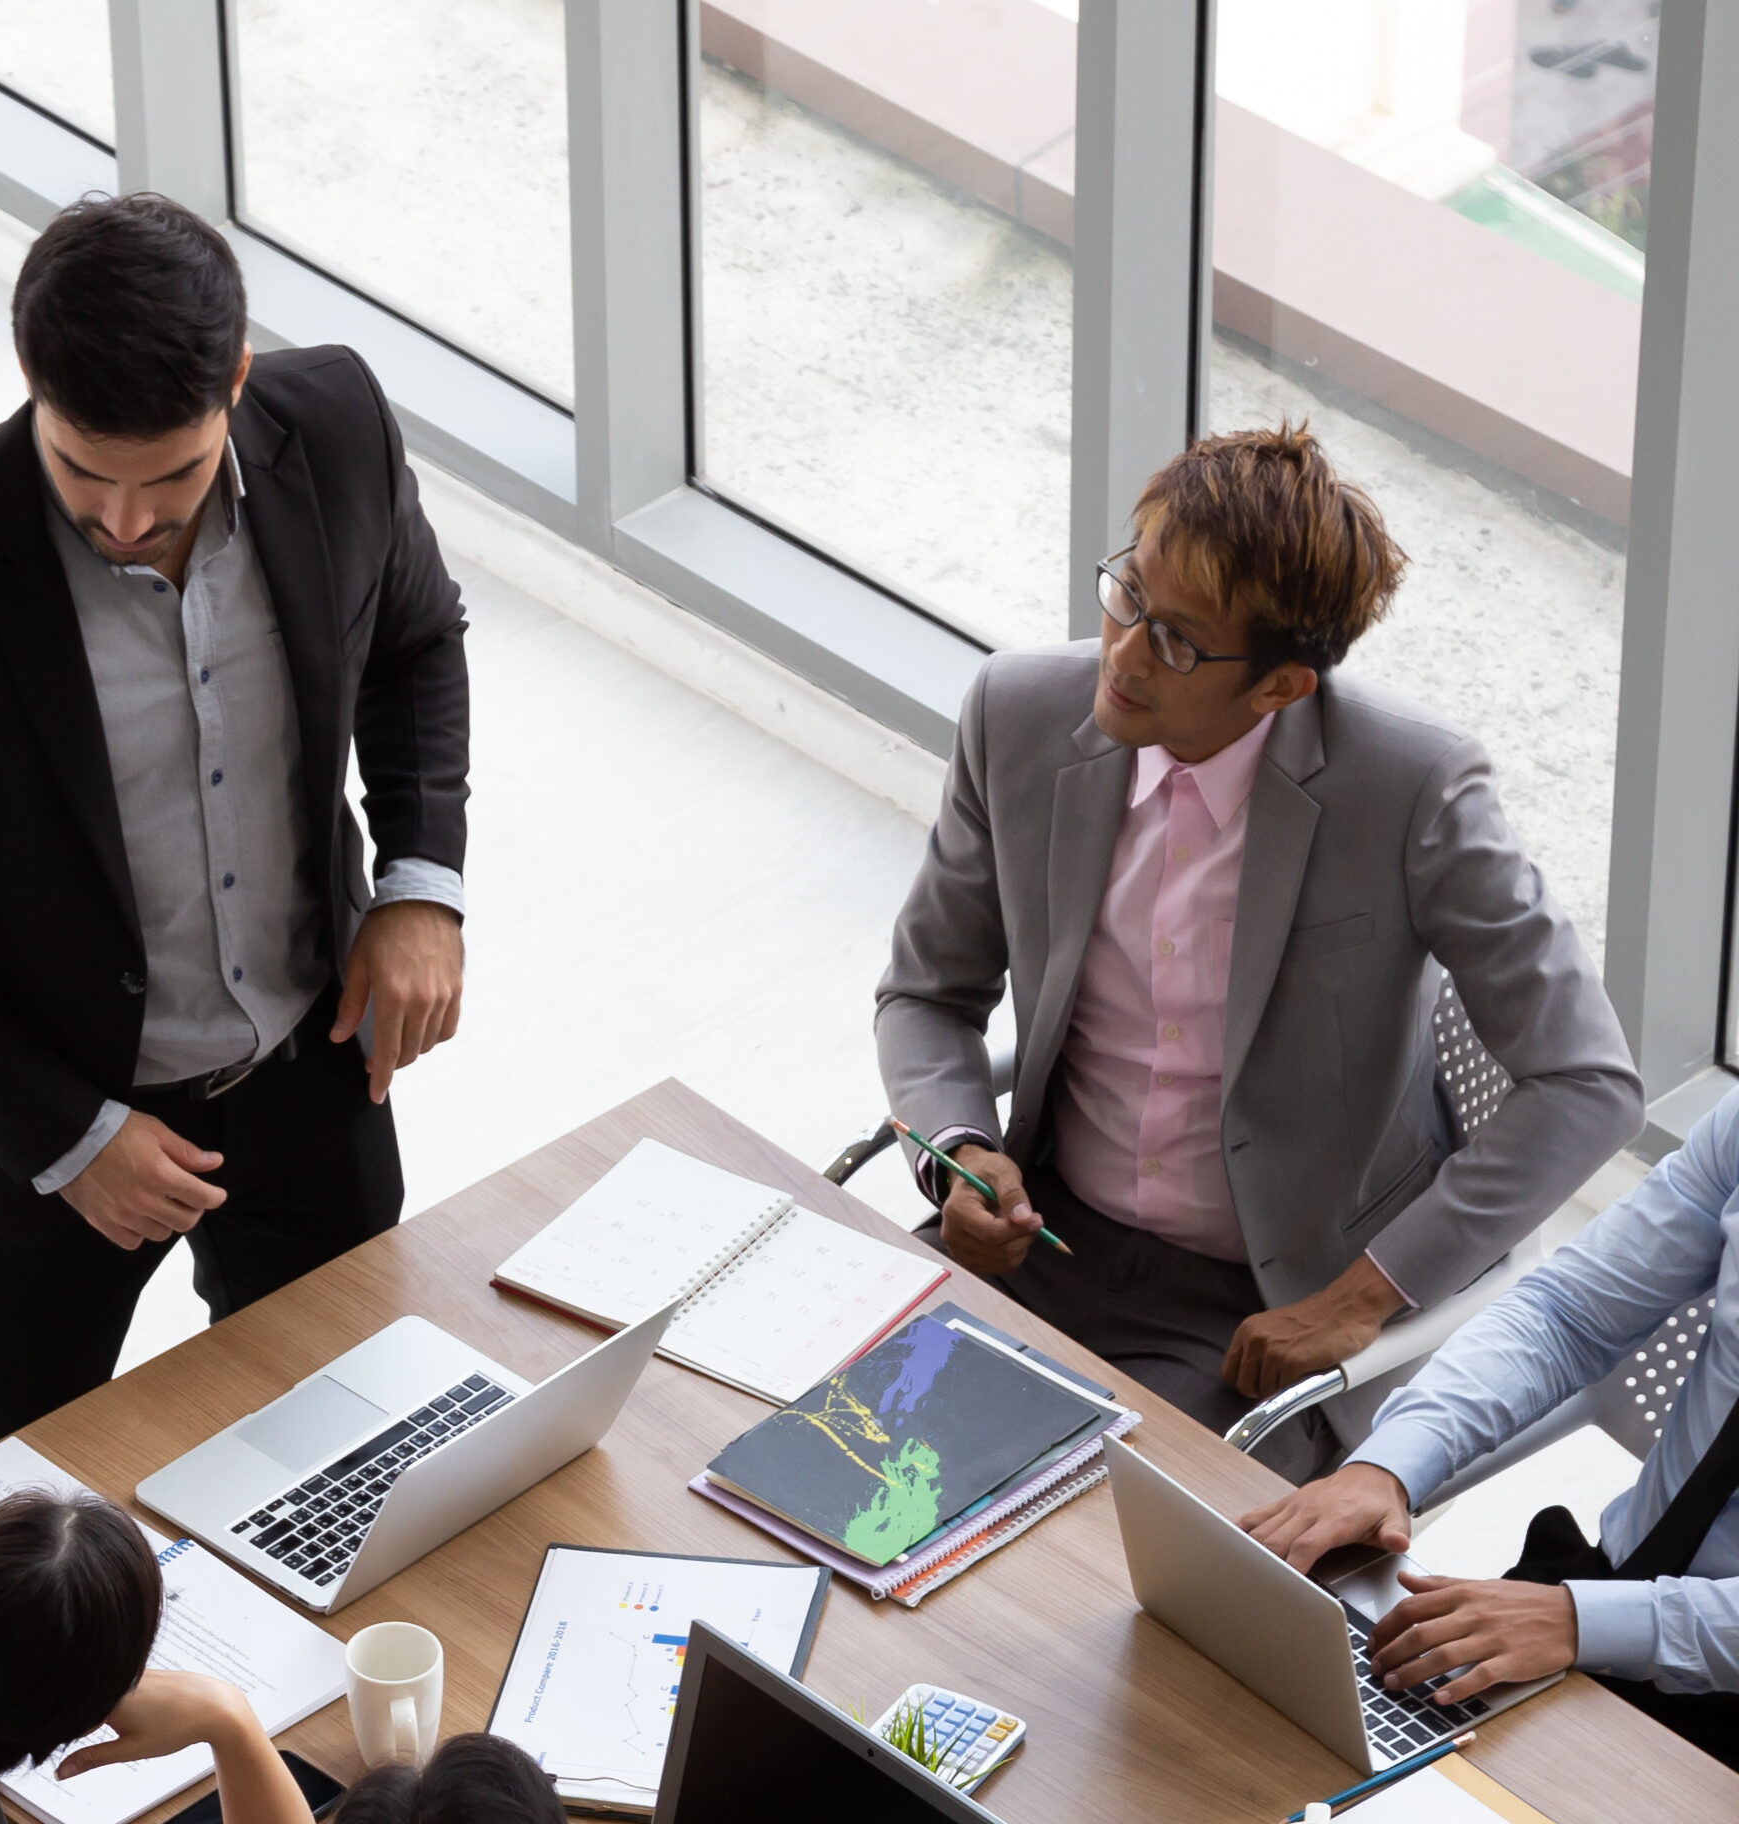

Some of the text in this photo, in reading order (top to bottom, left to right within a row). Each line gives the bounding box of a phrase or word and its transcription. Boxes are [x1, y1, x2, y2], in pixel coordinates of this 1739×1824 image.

[587, 1243, 600, 1253] 11
[524, 1621, 568, 1723] Product Compare 2016-2018
